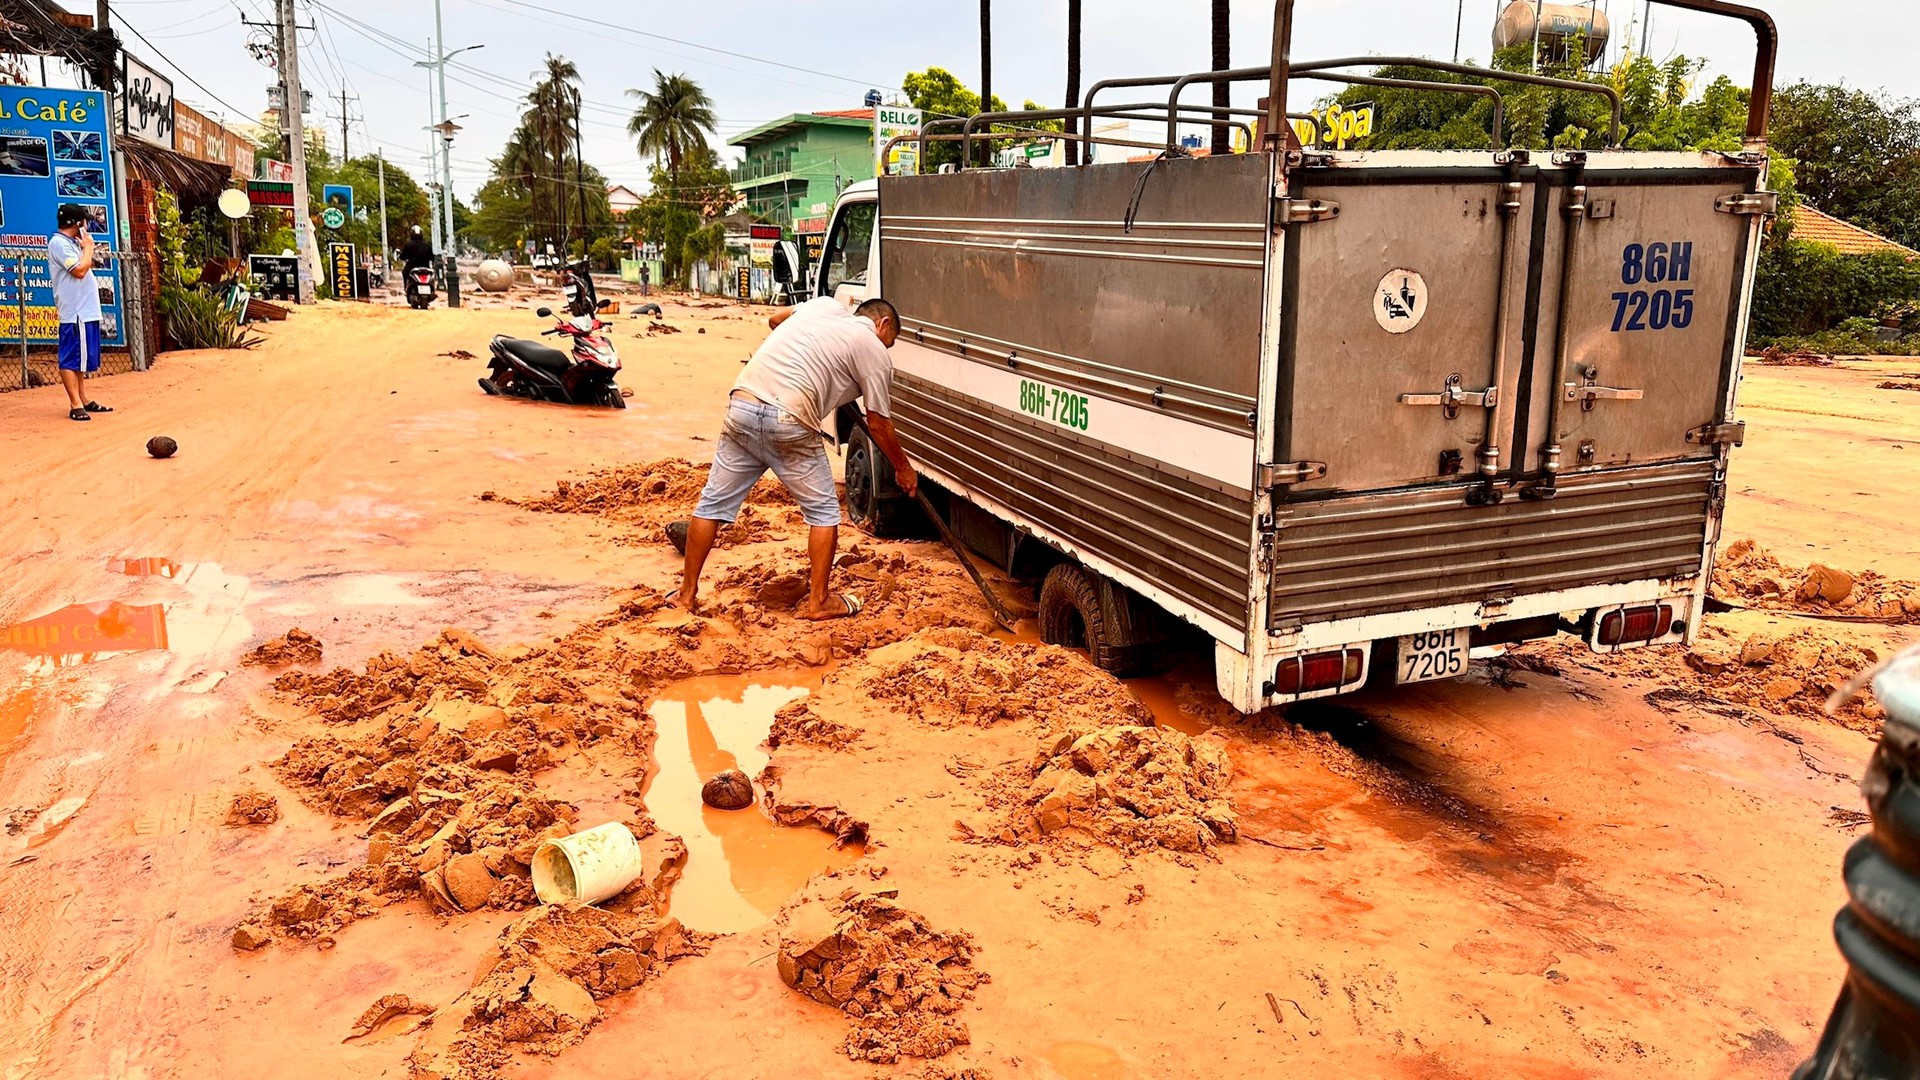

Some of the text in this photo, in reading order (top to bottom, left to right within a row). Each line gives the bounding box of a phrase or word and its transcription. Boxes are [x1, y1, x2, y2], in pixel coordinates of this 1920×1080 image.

[16, 98, 87, 122] Café
[1323, 103, 1372, 150] Spa
[250, 191, 292, 205] MASSAG
[2, 234, 48, 246] LIMOUSINE
[806, 236, 822, 246] DAY
[31, 265, 44, 274] AN
[334, 246, 350, 296] MASSAGE
[1622, 242, 1692, 284] 86H
[1610, 290, 1694, 332] 7205
[1020, 380, 1088, 430] 86H-7205
[1413, 630, 1455, 652] 86H
[1406, 648, 1461, 680] 7205
